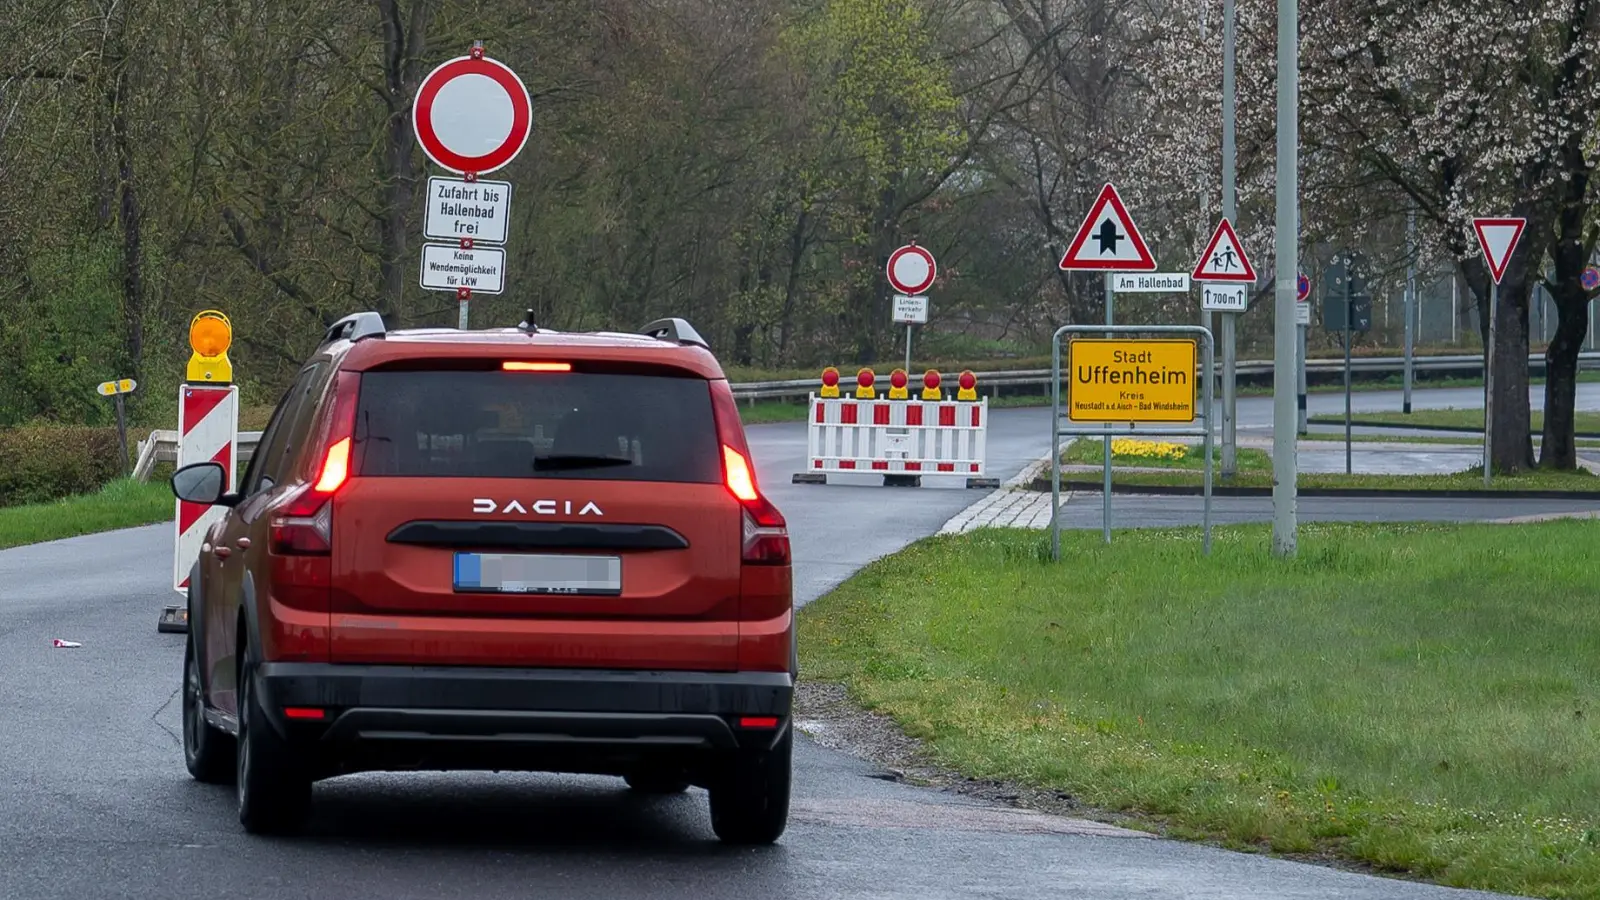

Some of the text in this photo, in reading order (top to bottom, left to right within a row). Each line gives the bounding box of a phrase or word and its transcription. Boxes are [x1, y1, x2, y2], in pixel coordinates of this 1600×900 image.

[438, 185, 500, 203] Zufahrt bis
[441, 202, 494, 218] Hallenbad
[454, 220, 479, 234] frei
[453, 251, 474, 261] Keine
[430, 262, 496, 275] Wendemöglichkeit
[446, 277, 478, 287] für LKW
[1120, 277, 1183, 288] Am Hallenbad
[1213, 293, 1235, 304] 700m
[1113, 350, 1152, 363] Stadt
[1078, 365, 1186, 384] Uffenheim
[1119, 391, 1144, 400] Kreis
[1075, 402, 1105, 410] Neustadt
[1139, 402, 1151, 410] Bad
[1153, 402, 1189, 410] Windsheim
[473, 499, 603, 515] DACIA
